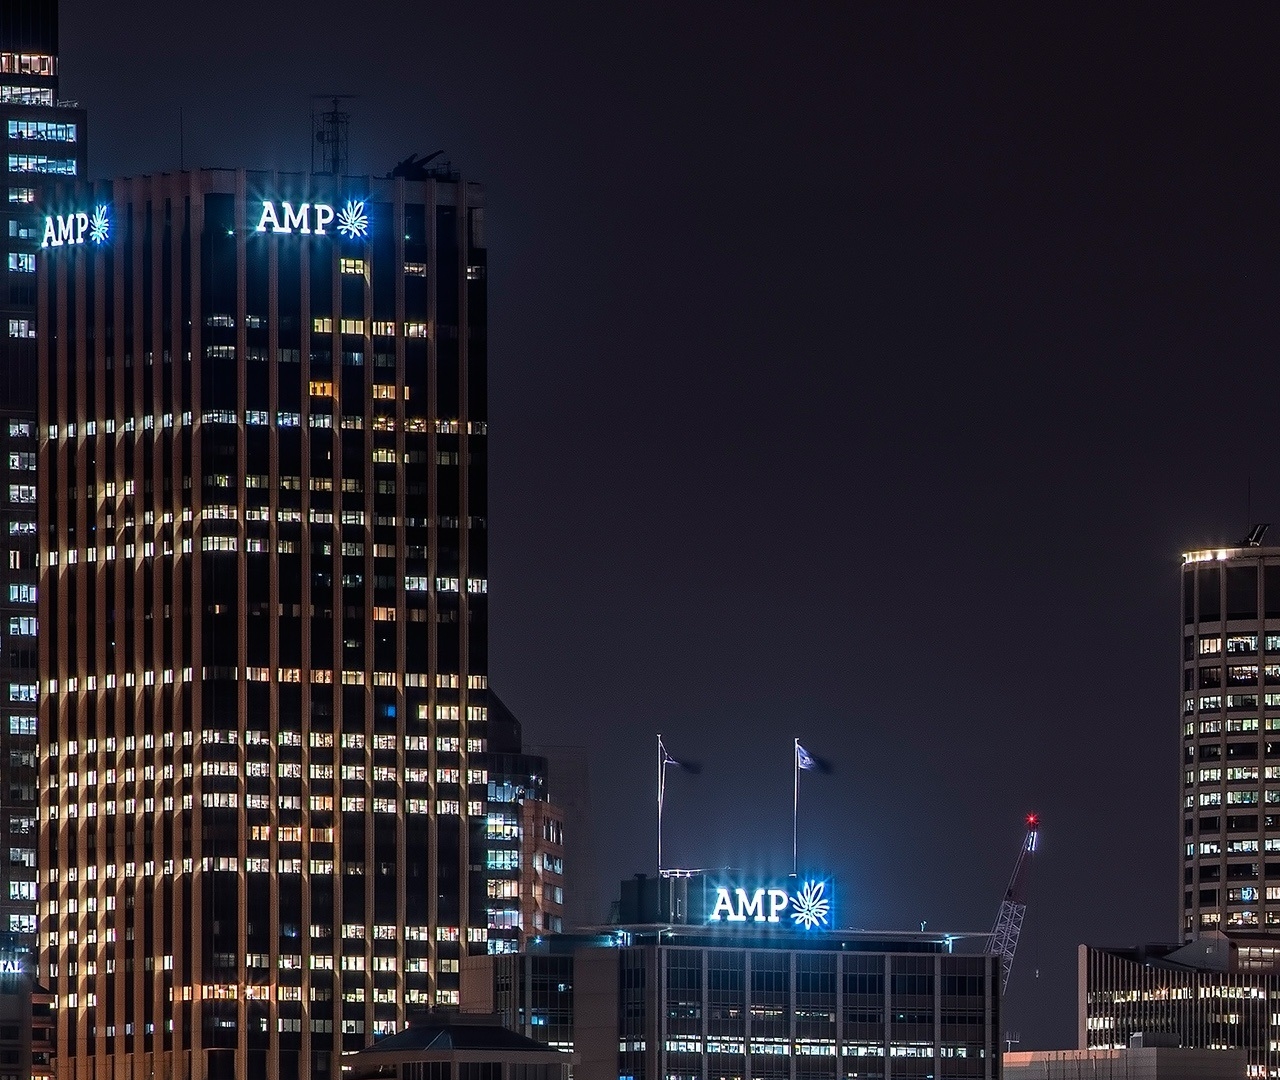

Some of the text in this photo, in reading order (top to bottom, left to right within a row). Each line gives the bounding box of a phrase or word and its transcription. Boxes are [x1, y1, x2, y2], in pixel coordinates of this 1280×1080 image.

[42, 212, 88, 248] AMP
[256, 201, 334, 235] AMP
[709, 887, 789, 923] AMP
